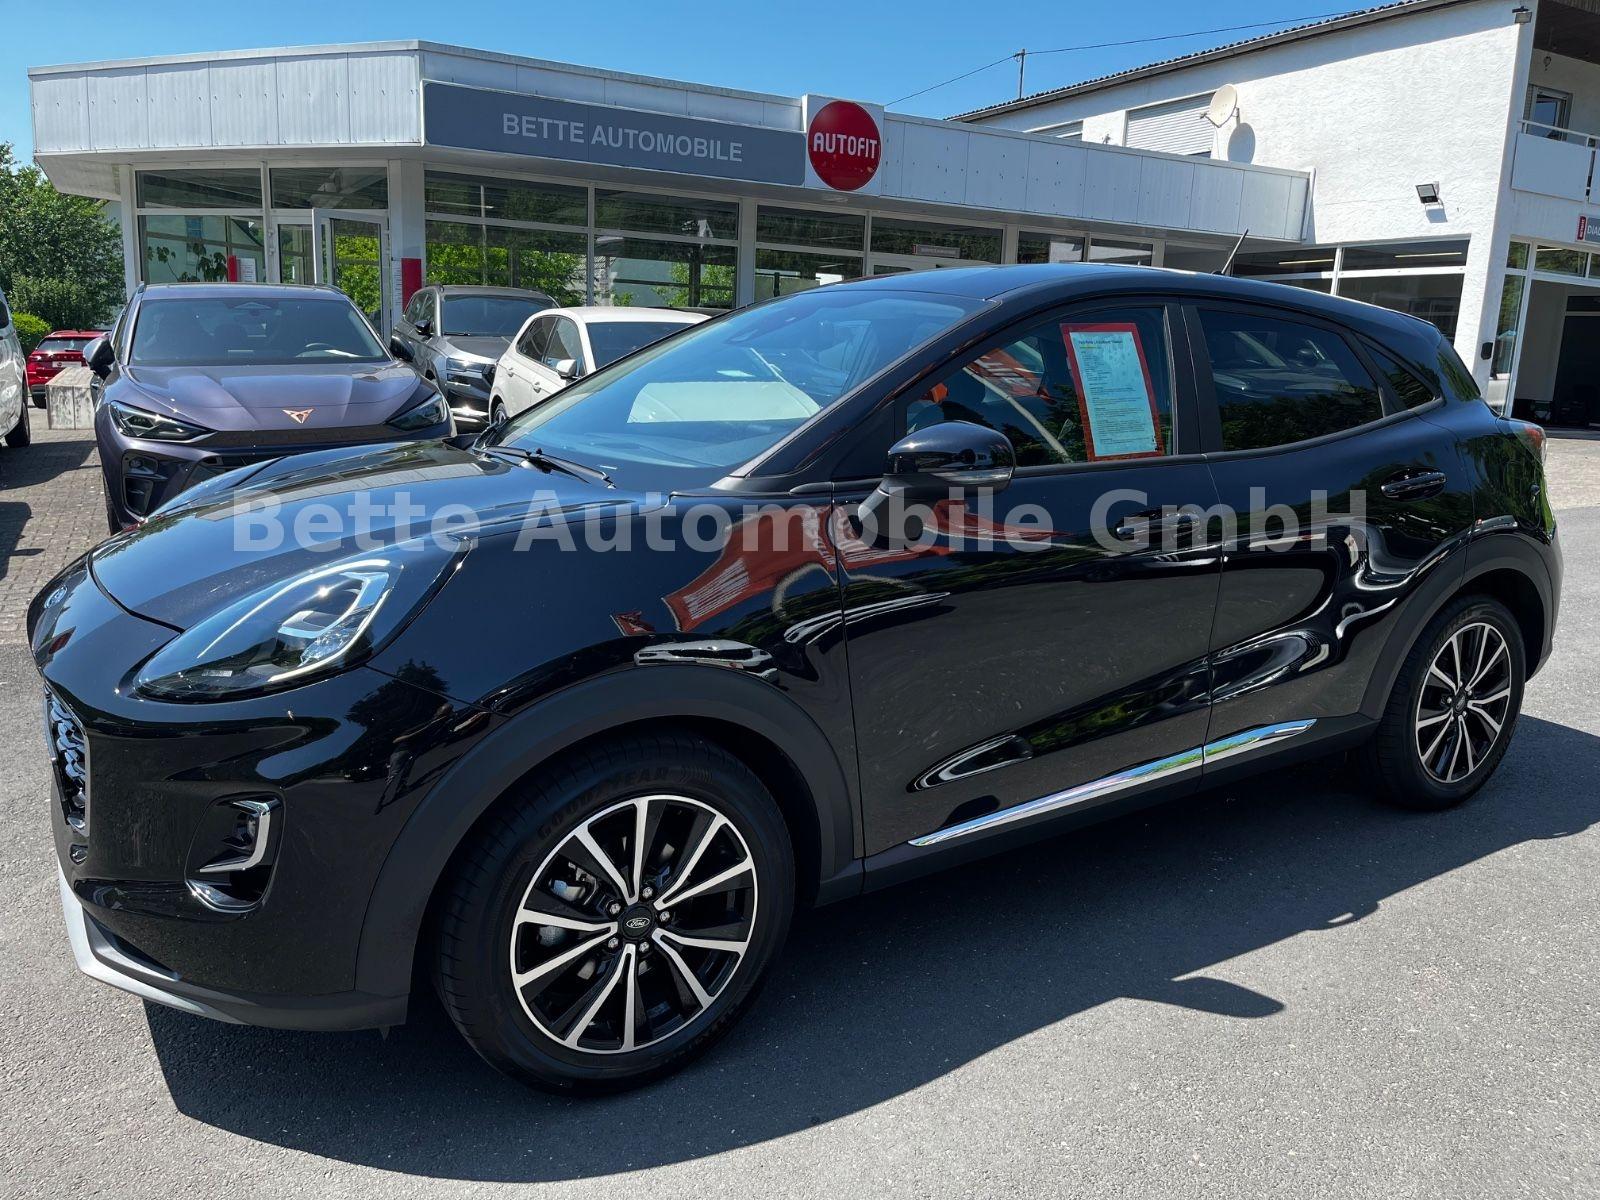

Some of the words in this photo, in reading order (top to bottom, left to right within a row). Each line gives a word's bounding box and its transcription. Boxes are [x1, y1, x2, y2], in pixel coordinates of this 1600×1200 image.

[503, 113, 585, 144] BETTE
[591, 125, 743, 162] AUTOMOBILE
[813, 132, 877, 159] AUTOFIT
